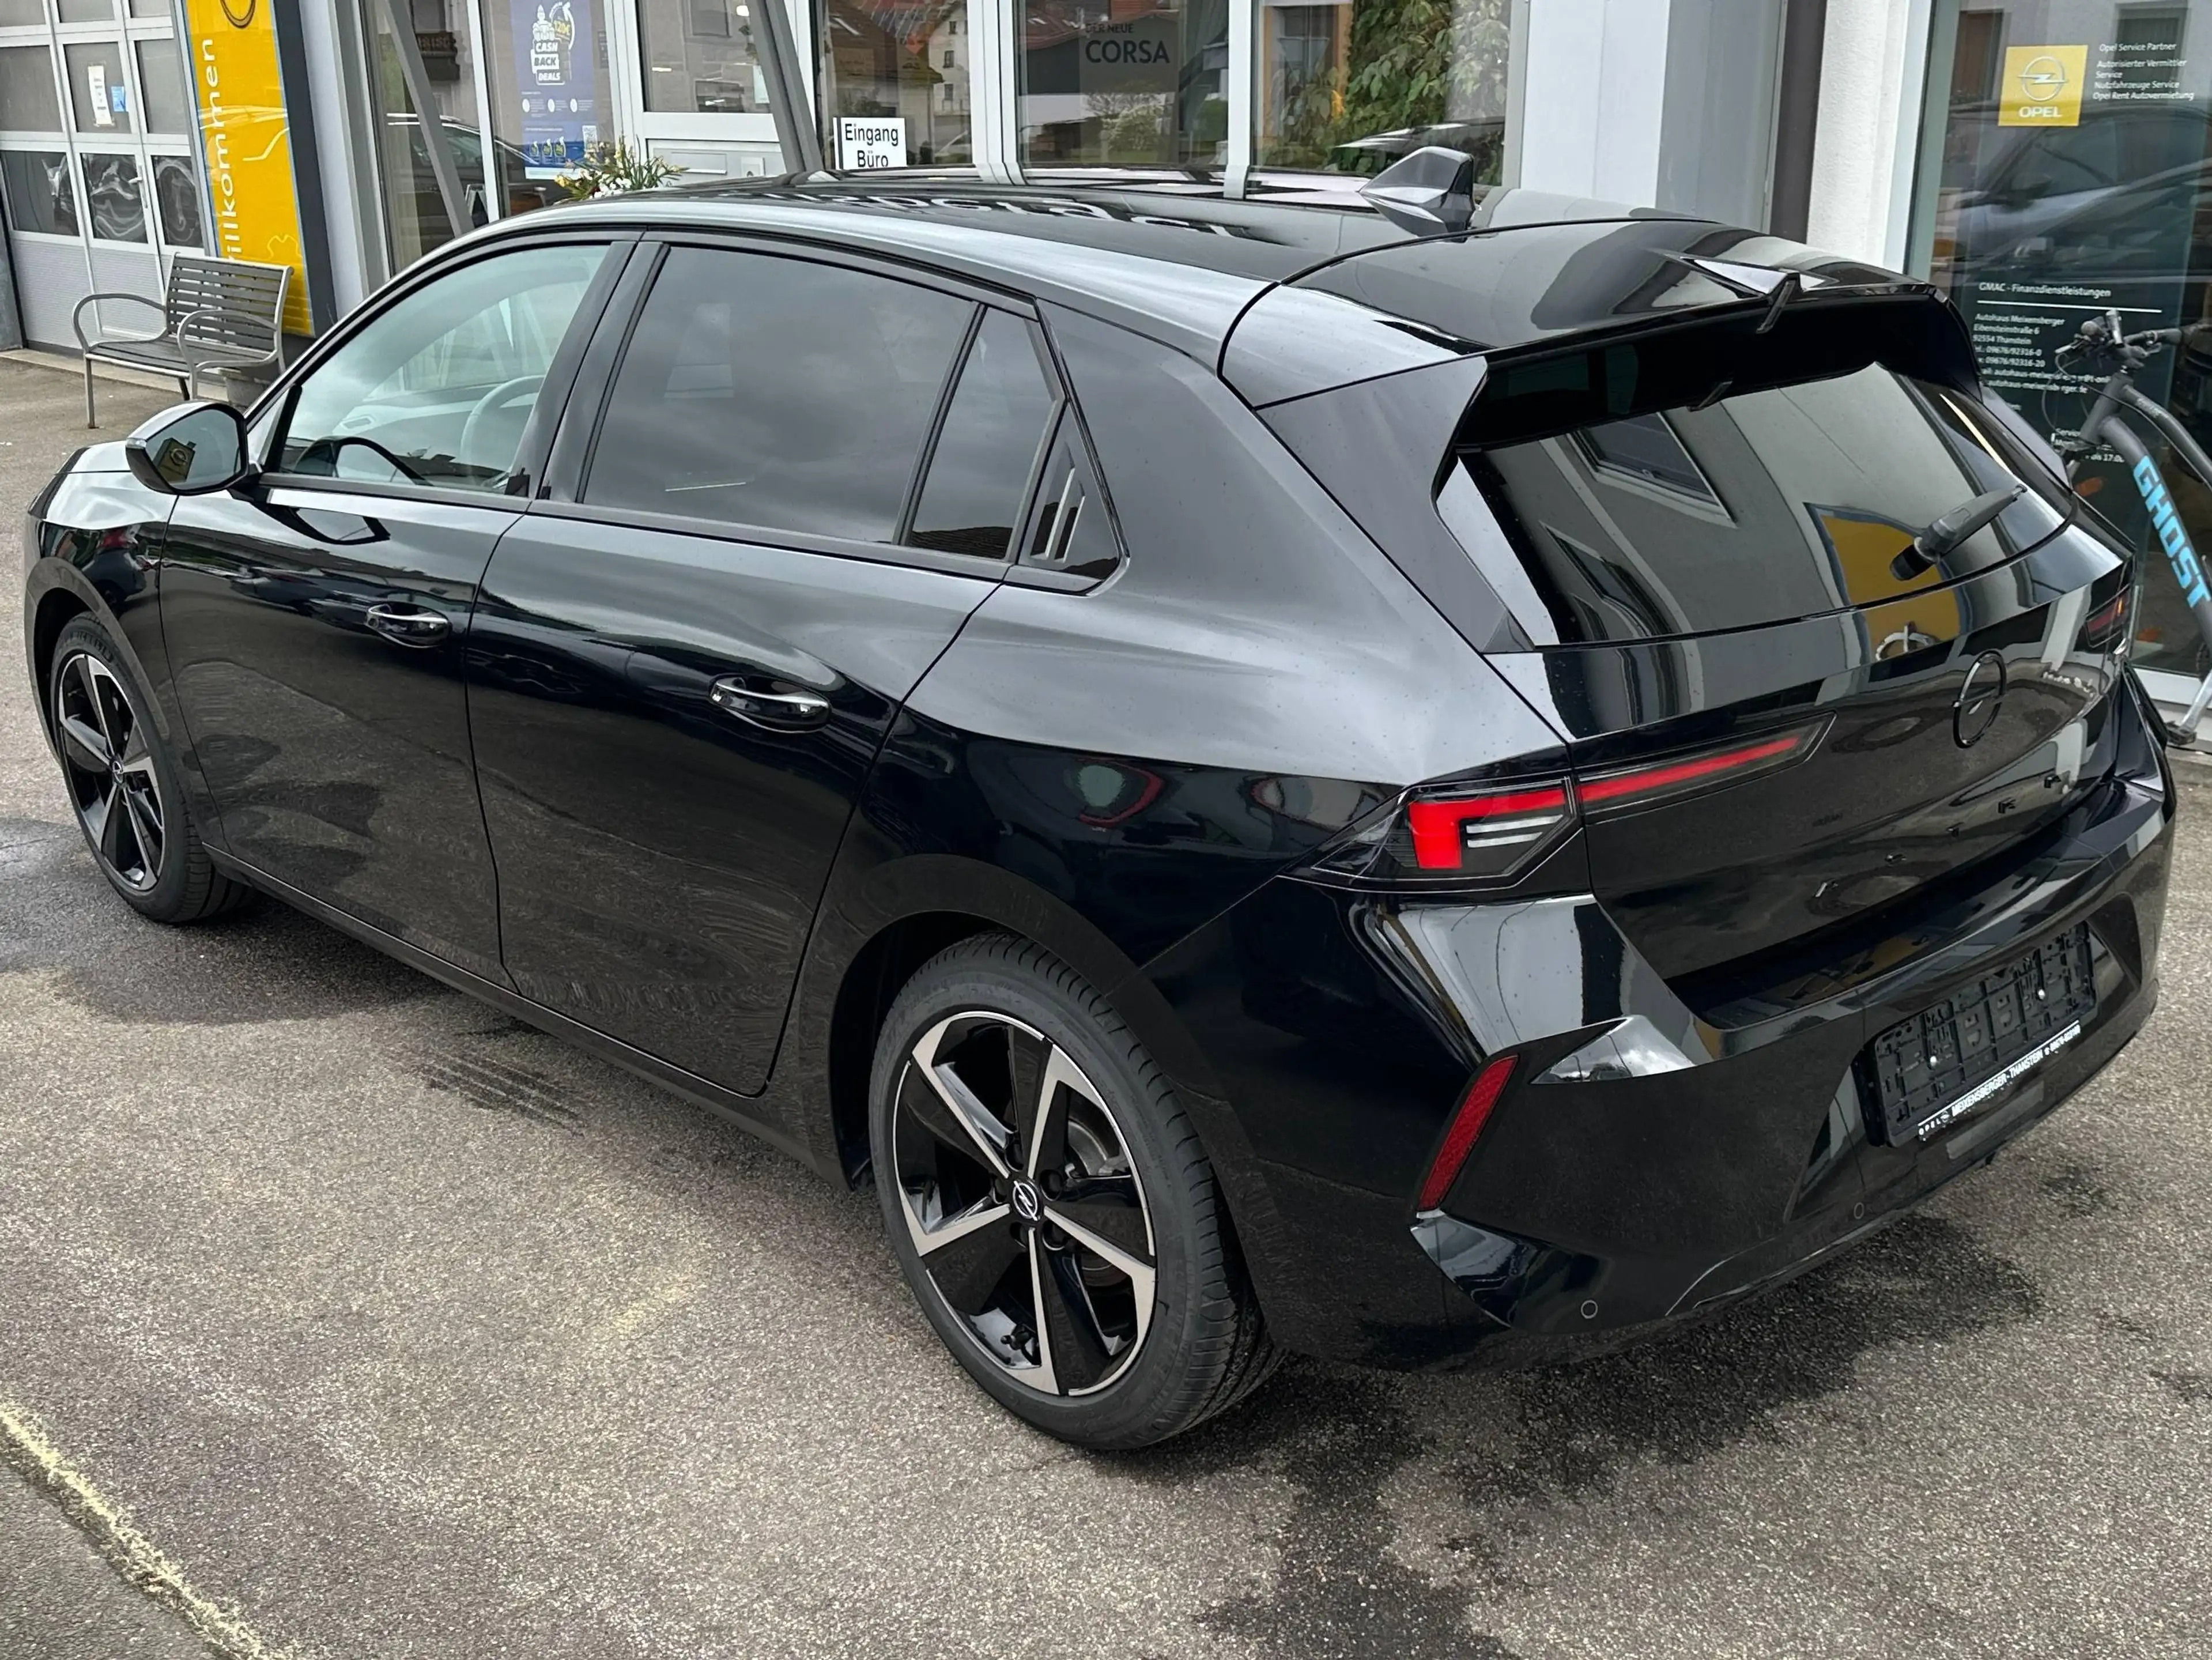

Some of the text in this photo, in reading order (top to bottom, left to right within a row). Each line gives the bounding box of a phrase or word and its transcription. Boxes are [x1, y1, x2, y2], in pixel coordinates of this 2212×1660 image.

[1107, 23, 1134, 33] NEUE
[535, 42, 558, 52] CASH
[1085, 40, 1171, 64] CORSA
[2099, 42, 2177, 53] Opel Service Partner
[534, 57, 557, 66] BACK
[538, 72, 561, 81] DEALS
[2095, 70, 2123, 78] Service
[2151, 80, 2180, 89] Service
[2092, 92, 2111, 101] Opel
[2018, 106, 2063, 118] OPEL
[845, 123, 899, 146] Eingang
[202, 39, 242, 261] illkommen
[857, 150, 889, 168] Büro
[1978, 281, 2006, 292] GMAC
[1975, 313, 2010, 322] Autohaus
[2033, 326, 2040, 335] 6
[2133, 455, 2211, 608] GHOST
